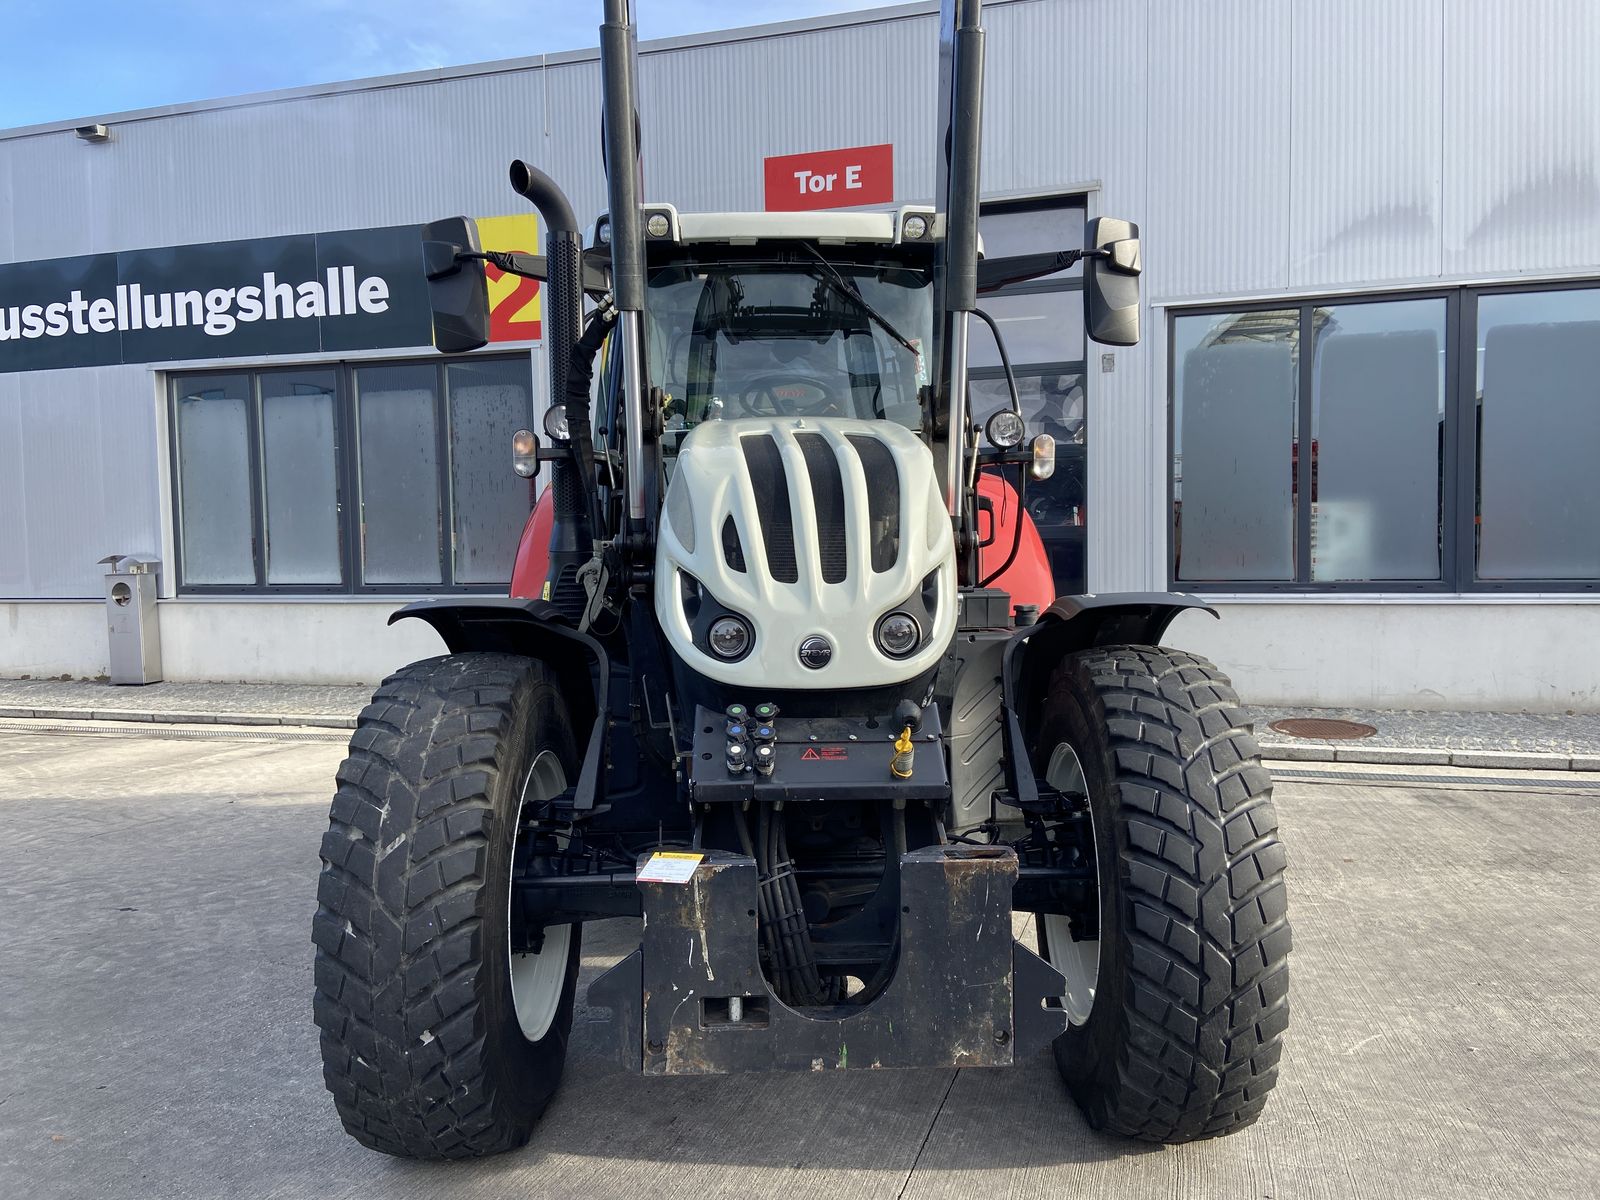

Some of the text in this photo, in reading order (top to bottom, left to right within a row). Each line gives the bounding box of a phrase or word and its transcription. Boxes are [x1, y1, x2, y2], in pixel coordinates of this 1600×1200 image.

[794, 165, 863, 194] Tor E
[0, 250, 542, 342] usstellungshalle 2
